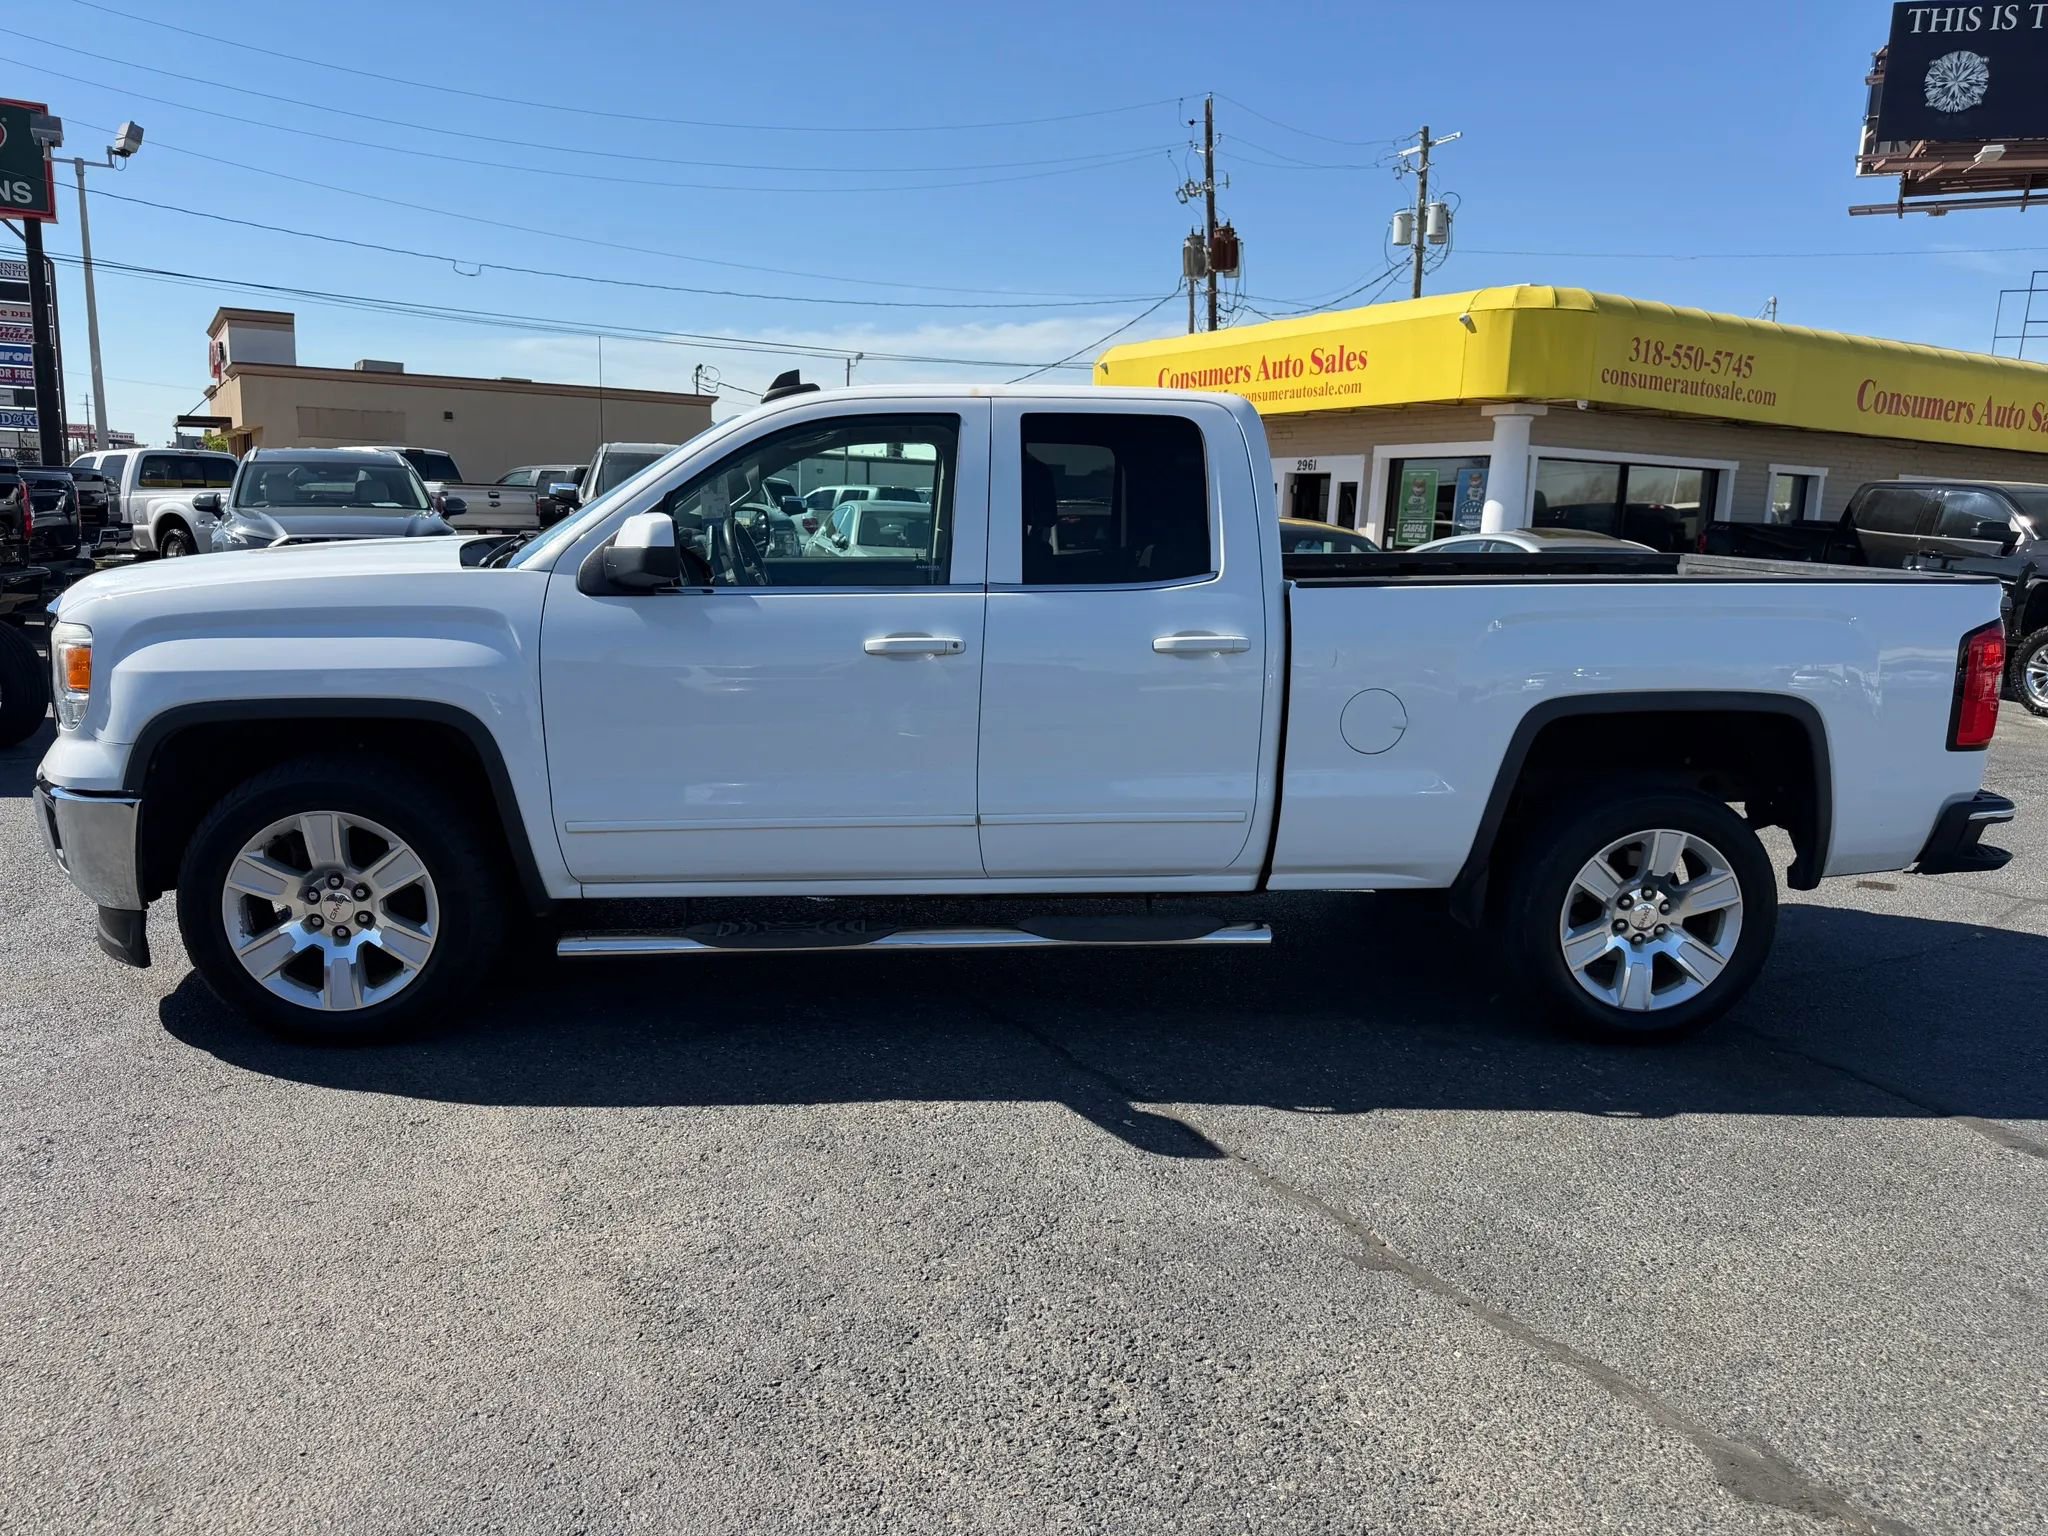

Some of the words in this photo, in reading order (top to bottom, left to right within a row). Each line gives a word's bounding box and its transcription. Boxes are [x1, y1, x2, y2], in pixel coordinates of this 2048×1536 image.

[1907, 6, 1983, 34] THIS
[1989, 4, 2019, 31] IS
[1157, 364, 1251, 390] Consumers
[1256, 354, 1304, 382] Auto
[1309, 344, 1369, 376] Sales
[1628, 336, 1755, 379] 318-550-5745
[1601, 366, 1777, 407] consumerautosale.com
[1856, 379, 1976, 425] Consumers
[1977, 395, 2026, 431] Auto
[1296, 459, 1317, 472] 2961
